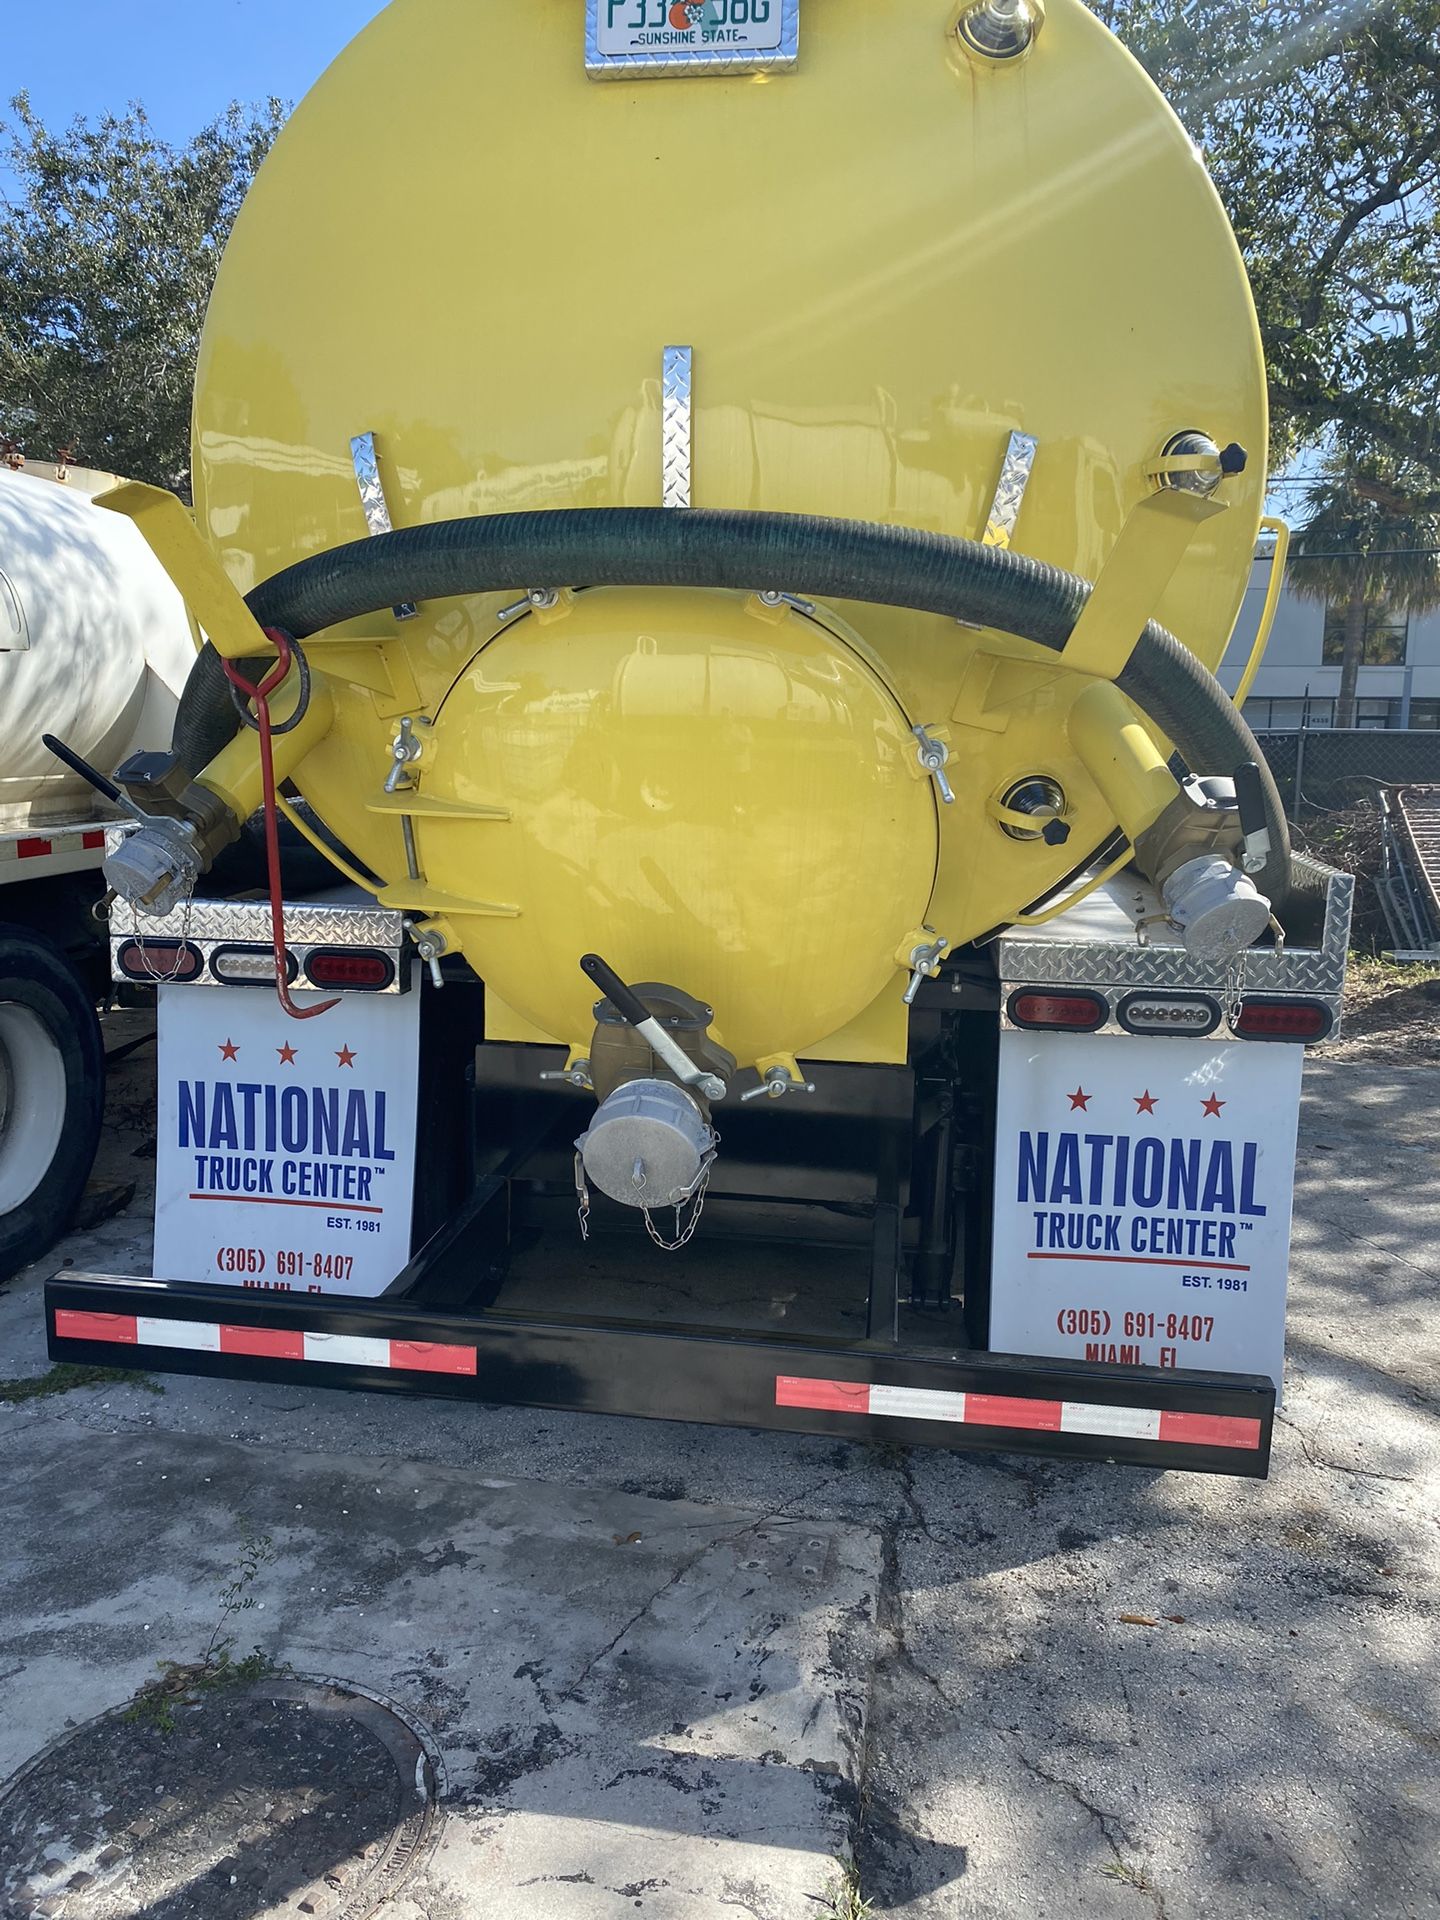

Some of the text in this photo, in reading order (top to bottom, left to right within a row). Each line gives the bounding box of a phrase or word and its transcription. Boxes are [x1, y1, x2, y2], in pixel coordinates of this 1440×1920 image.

[638, 29, 739, 45] SUNSHINE STATE
[178, 1080, 395, 1161] NATIONAL
[195, 1155, 274, 1193] TRUCK
[1017, 1131, 1267, 1217] NATIONAL
[327, 1217, 381, 1233] EST. 1981
[1033, 1211, 1122, 1251] TRUCK
[216, 1247, 354, 1281] (305) 691-8407
[1182, 1275, 1248, 1292] EST. 1981
[1057, 1309, 1215, 1343] (305) 691-8407
